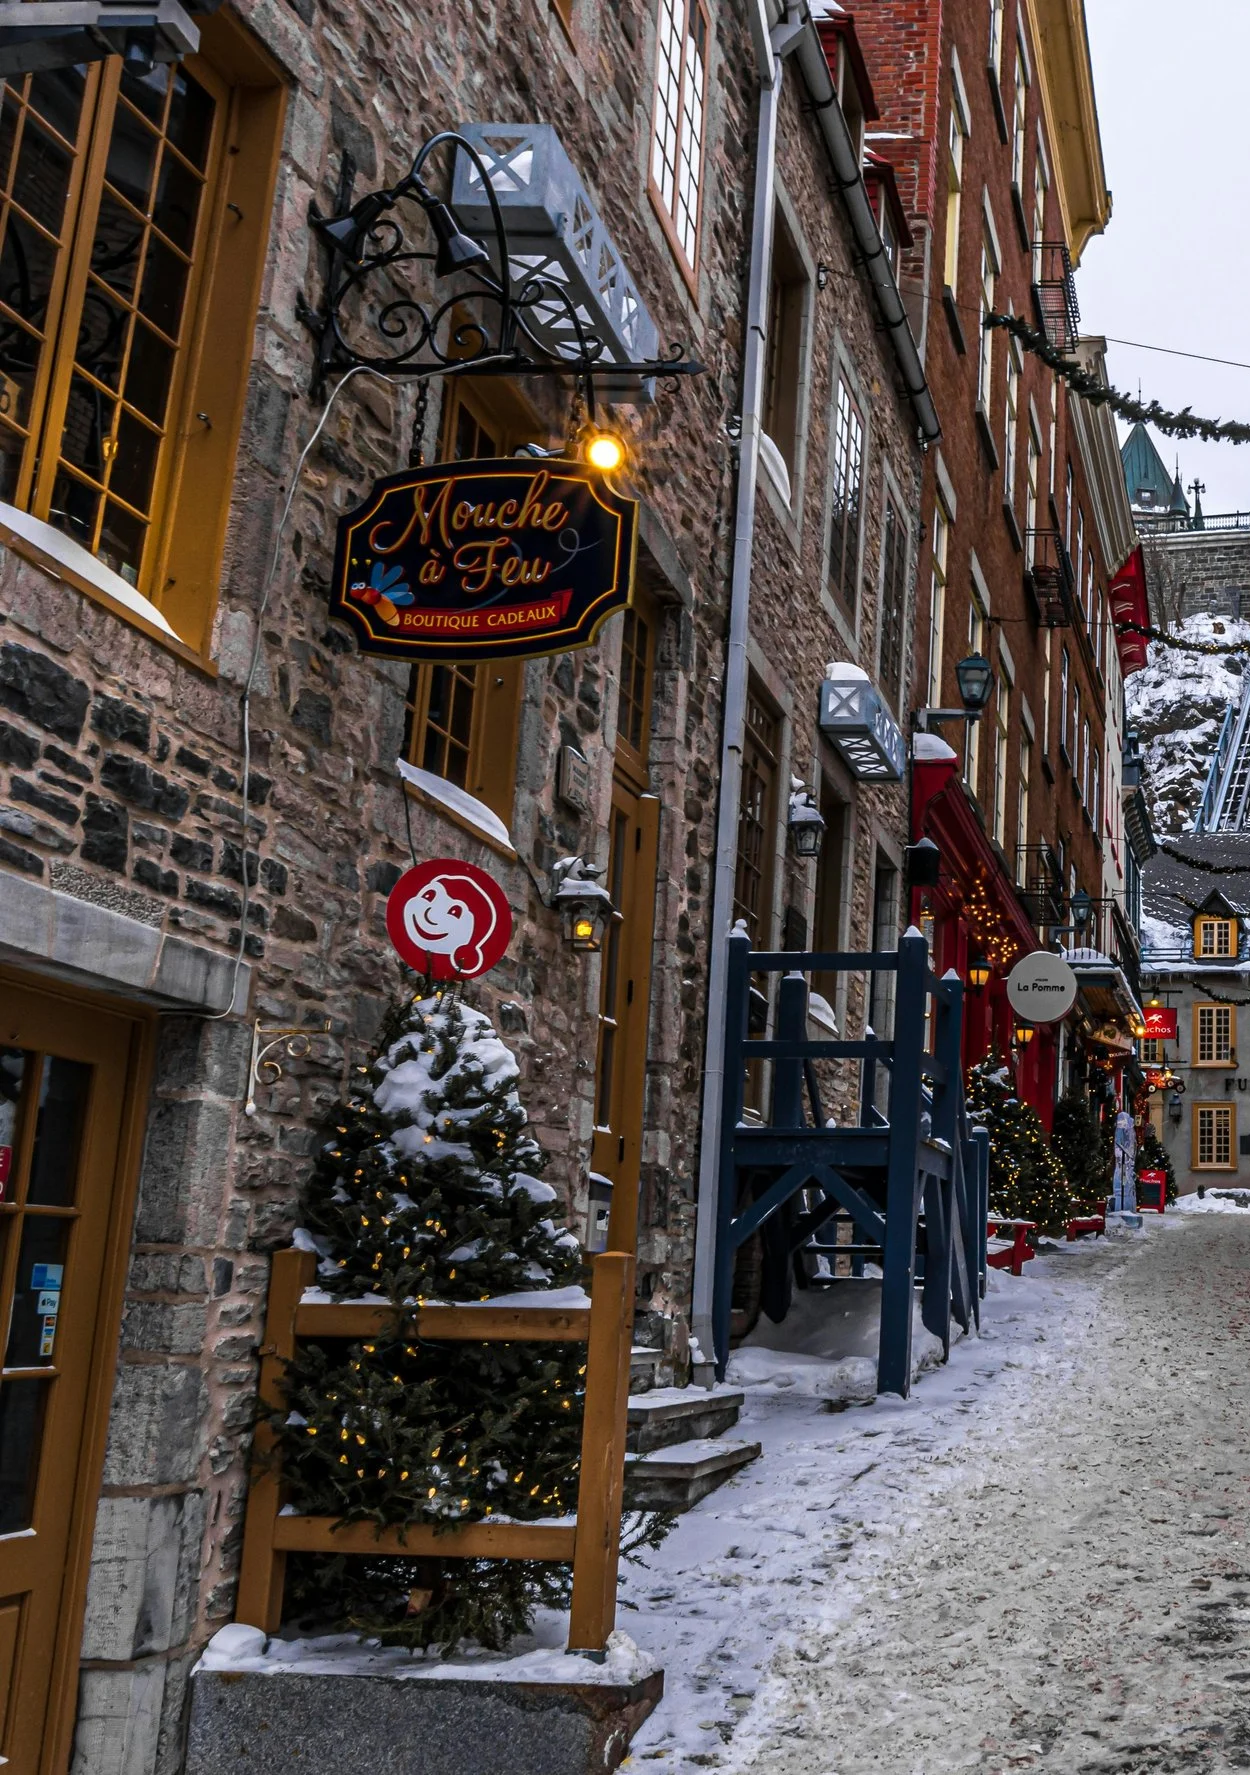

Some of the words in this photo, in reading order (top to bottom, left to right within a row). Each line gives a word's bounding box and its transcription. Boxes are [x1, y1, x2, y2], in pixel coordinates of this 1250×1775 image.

[368, 468, 571, 552] Mouche
[418, 548, 447, 585] à
[452, 535, 552, 594] Feu
[402, 612, 481, 631] BOUTIQUE
[486, 604, 557, 628] CADEAUX
[1017, 982, 1029, 992] La
[1031, 982, 1065, 992] Pomme
